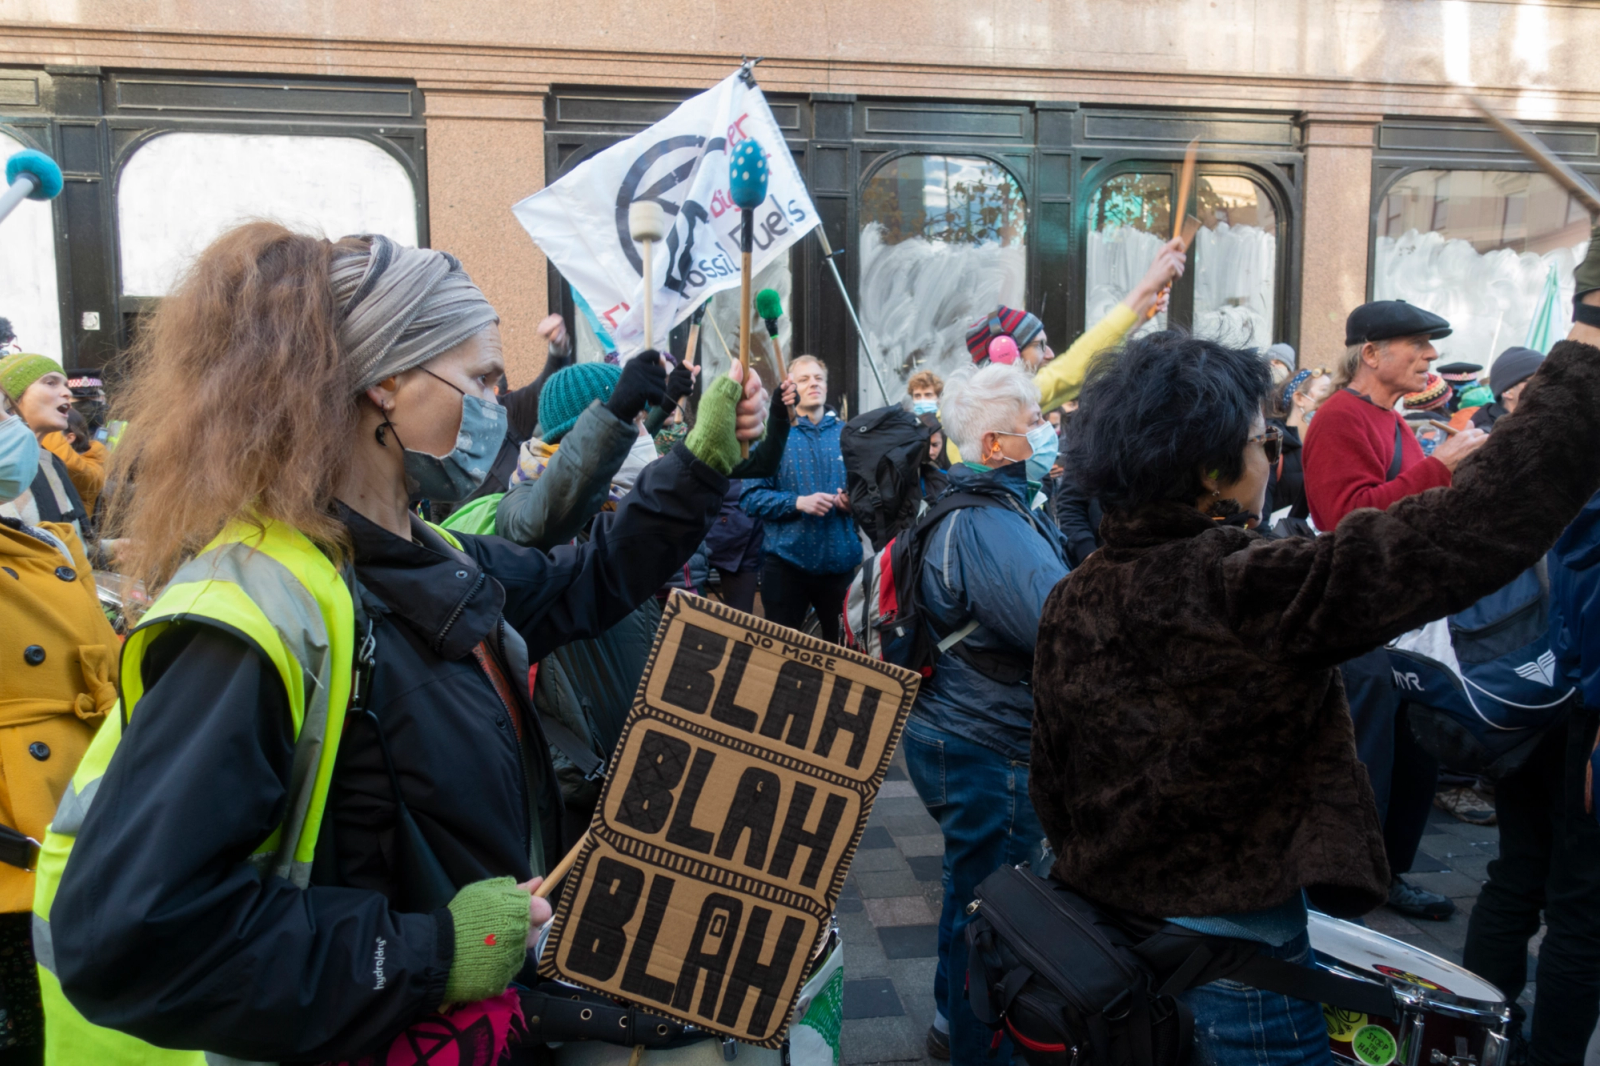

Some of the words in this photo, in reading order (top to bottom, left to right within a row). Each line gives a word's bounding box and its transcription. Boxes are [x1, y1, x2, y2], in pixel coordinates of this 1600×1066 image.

[660, 622, 882, 770] BLAH
[744, 632, 774, 649] NO
[781, 644, 837, 672] MORE
[614, 728, 848, 889] BLAH
[565, 855, 806, 1037] BLAH
[1357, 1042, 1381, 1063] HARM
